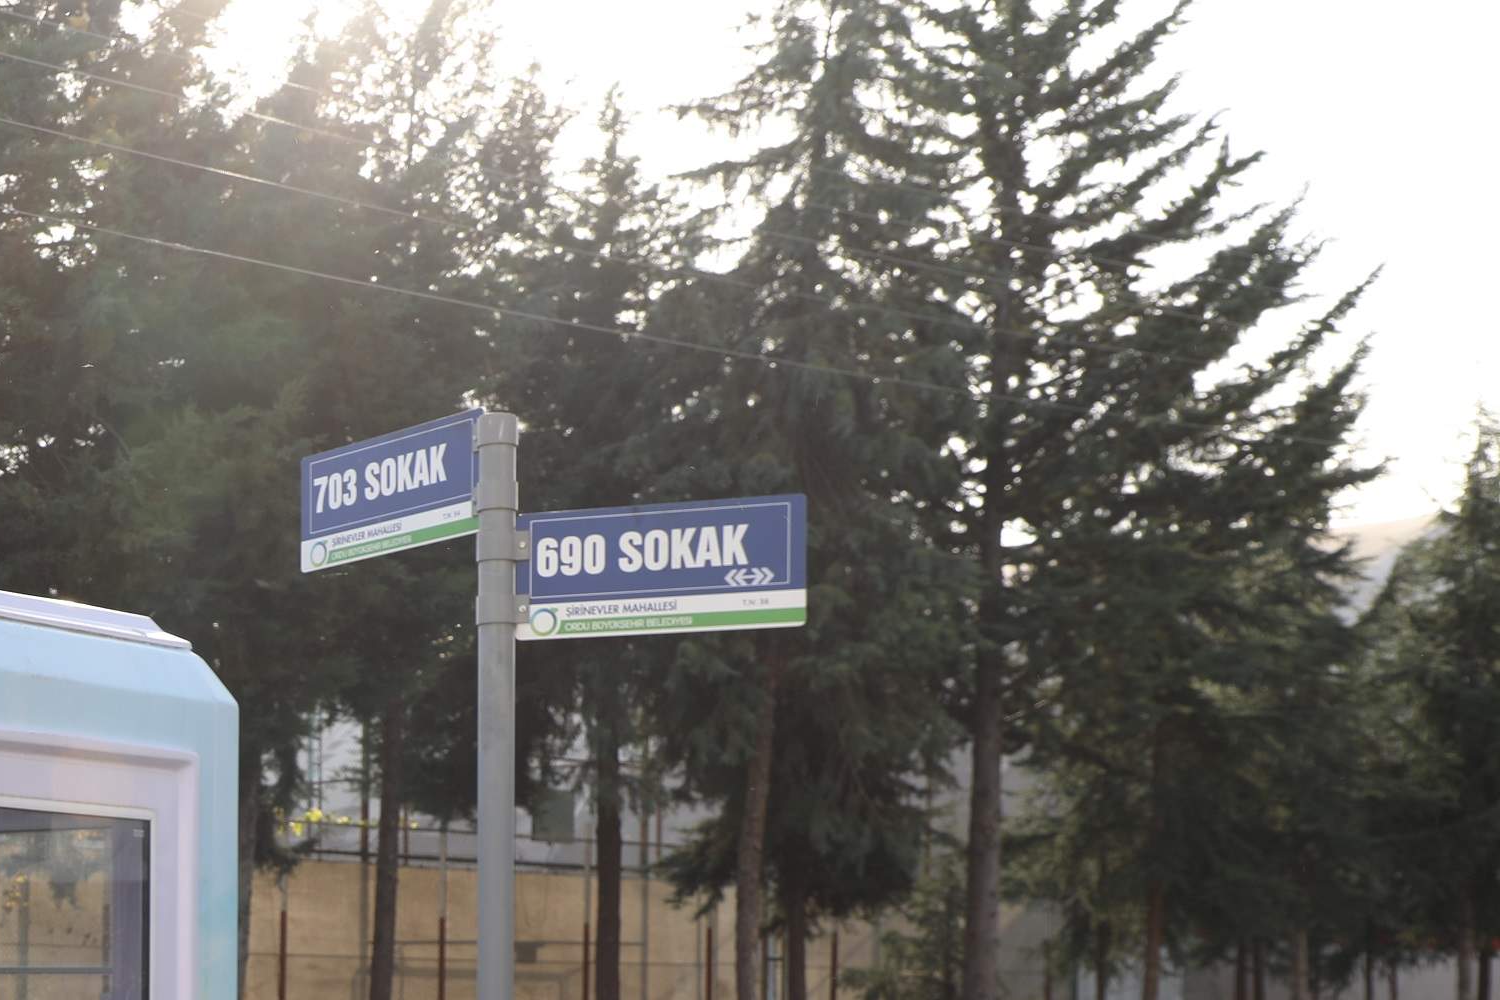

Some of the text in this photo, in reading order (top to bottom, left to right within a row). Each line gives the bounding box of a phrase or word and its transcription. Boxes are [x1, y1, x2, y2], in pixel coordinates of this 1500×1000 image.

[313, 443, 448, 514] 703 SOKAK
[536, 523, 749, 578] 690 SOKAK
[565, 599, 677, 618] ŞİRİNEVLER MAHALLESİ
